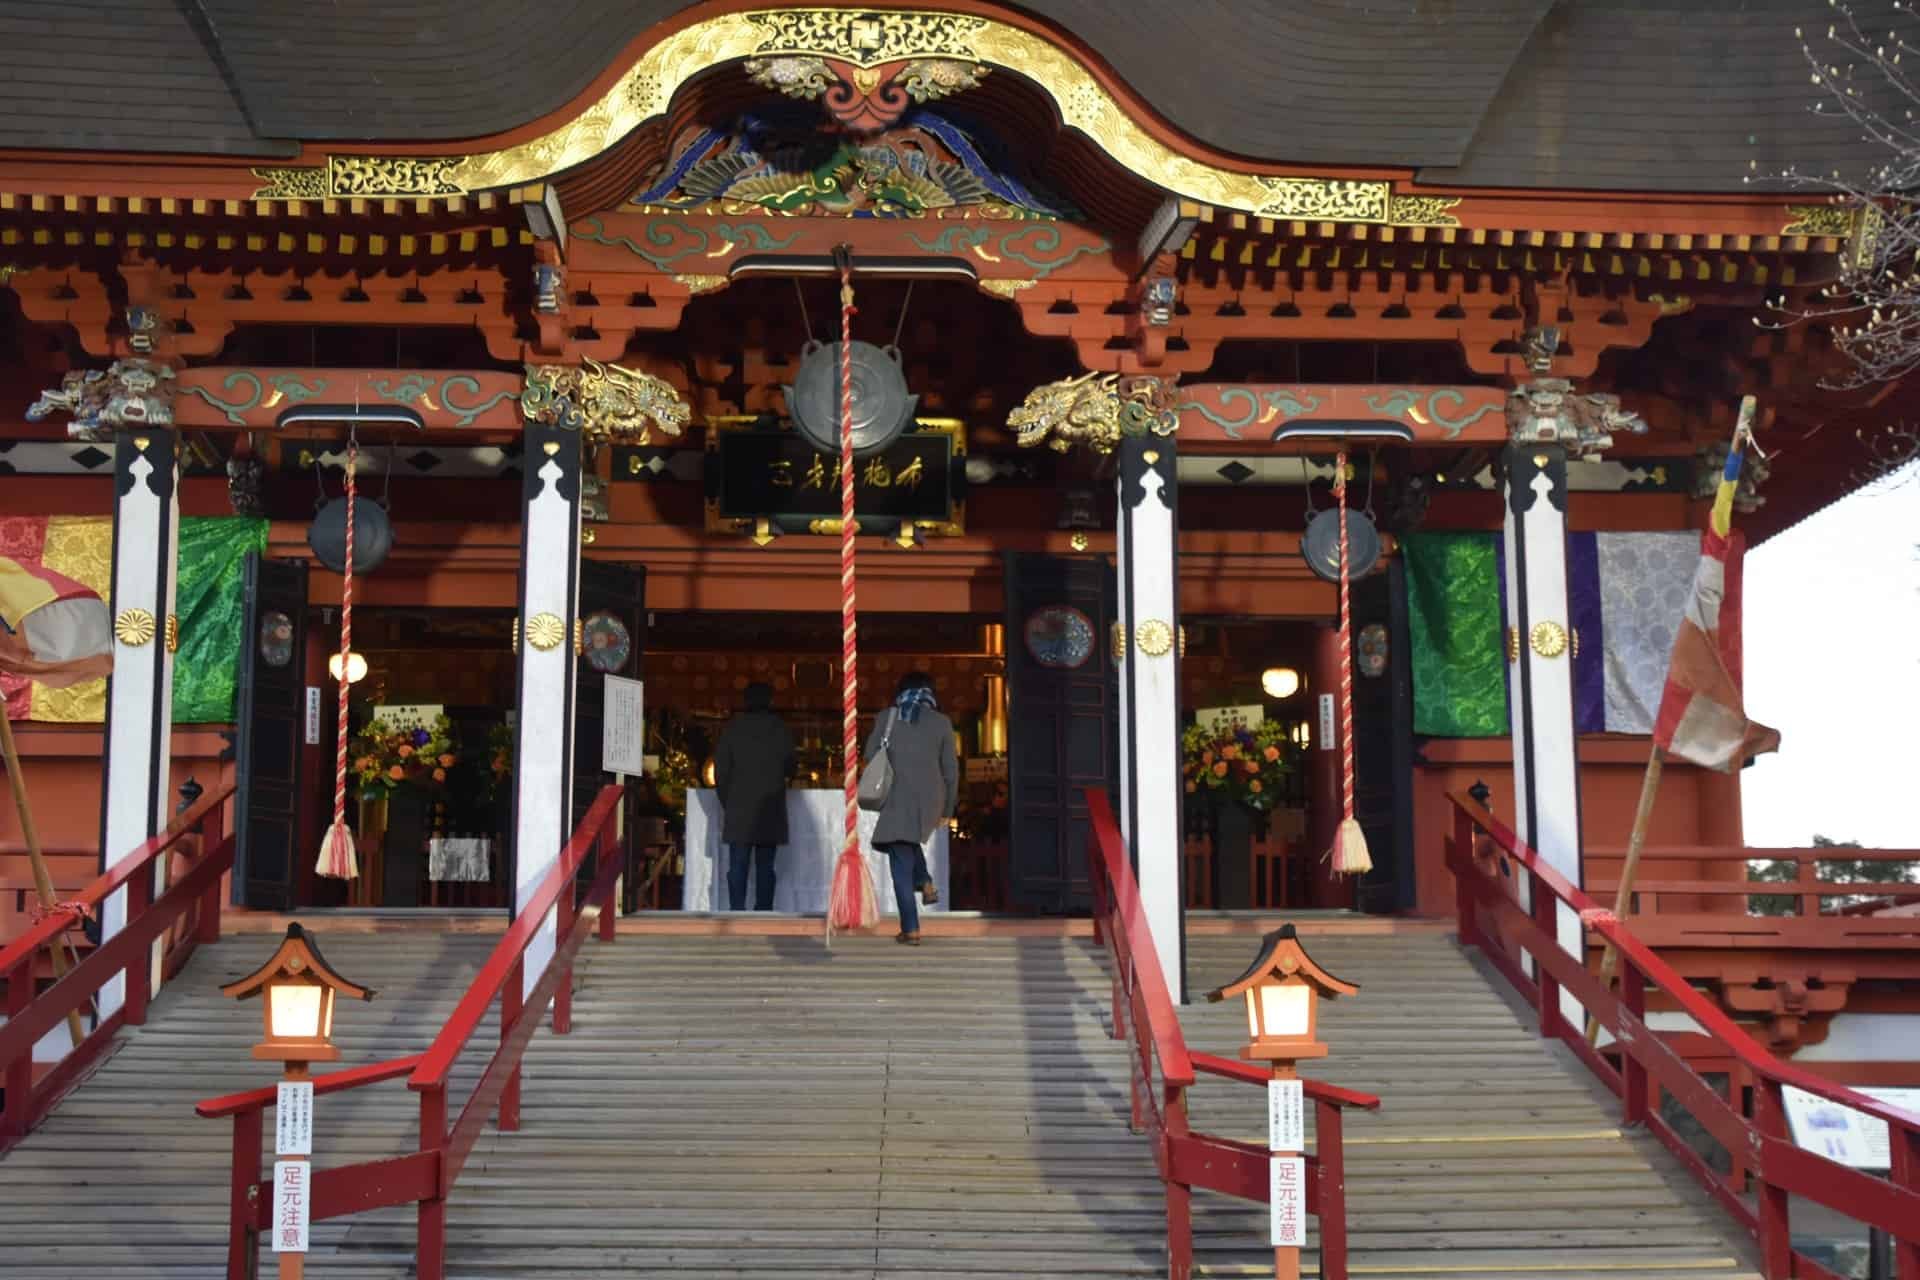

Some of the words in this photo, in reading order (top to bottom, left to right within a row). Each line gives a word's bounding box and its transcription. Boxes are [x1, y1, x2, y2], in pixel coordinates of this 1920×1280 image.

[281, 1166, 302, 1248] 足元注意
[1279, 1162, 1297, 1242] 足元注意
